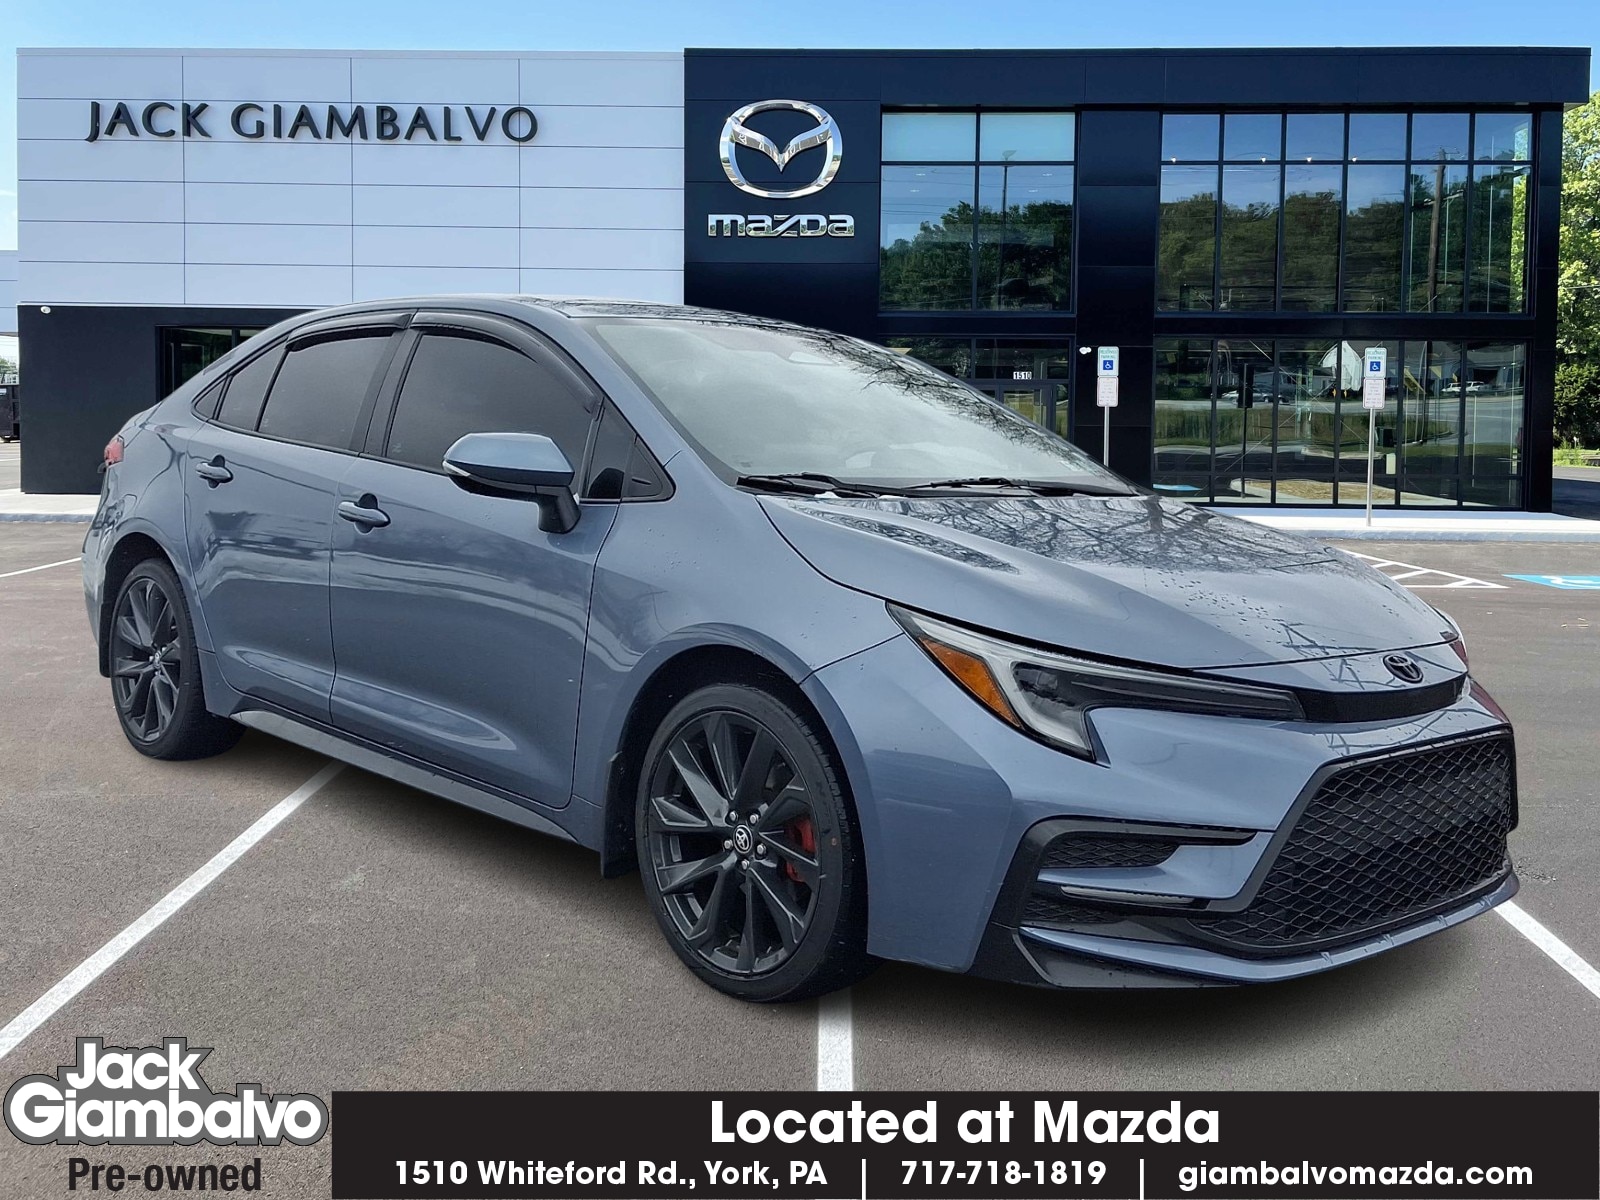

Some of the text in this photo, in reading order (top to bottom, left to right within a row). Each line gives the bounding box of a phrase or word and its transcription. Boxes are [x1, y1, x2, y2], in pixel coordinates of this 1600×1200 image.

[85, 101, 539, 142] JACK GIAMBALVO
[1013, 371, 1032, 380] 1510
